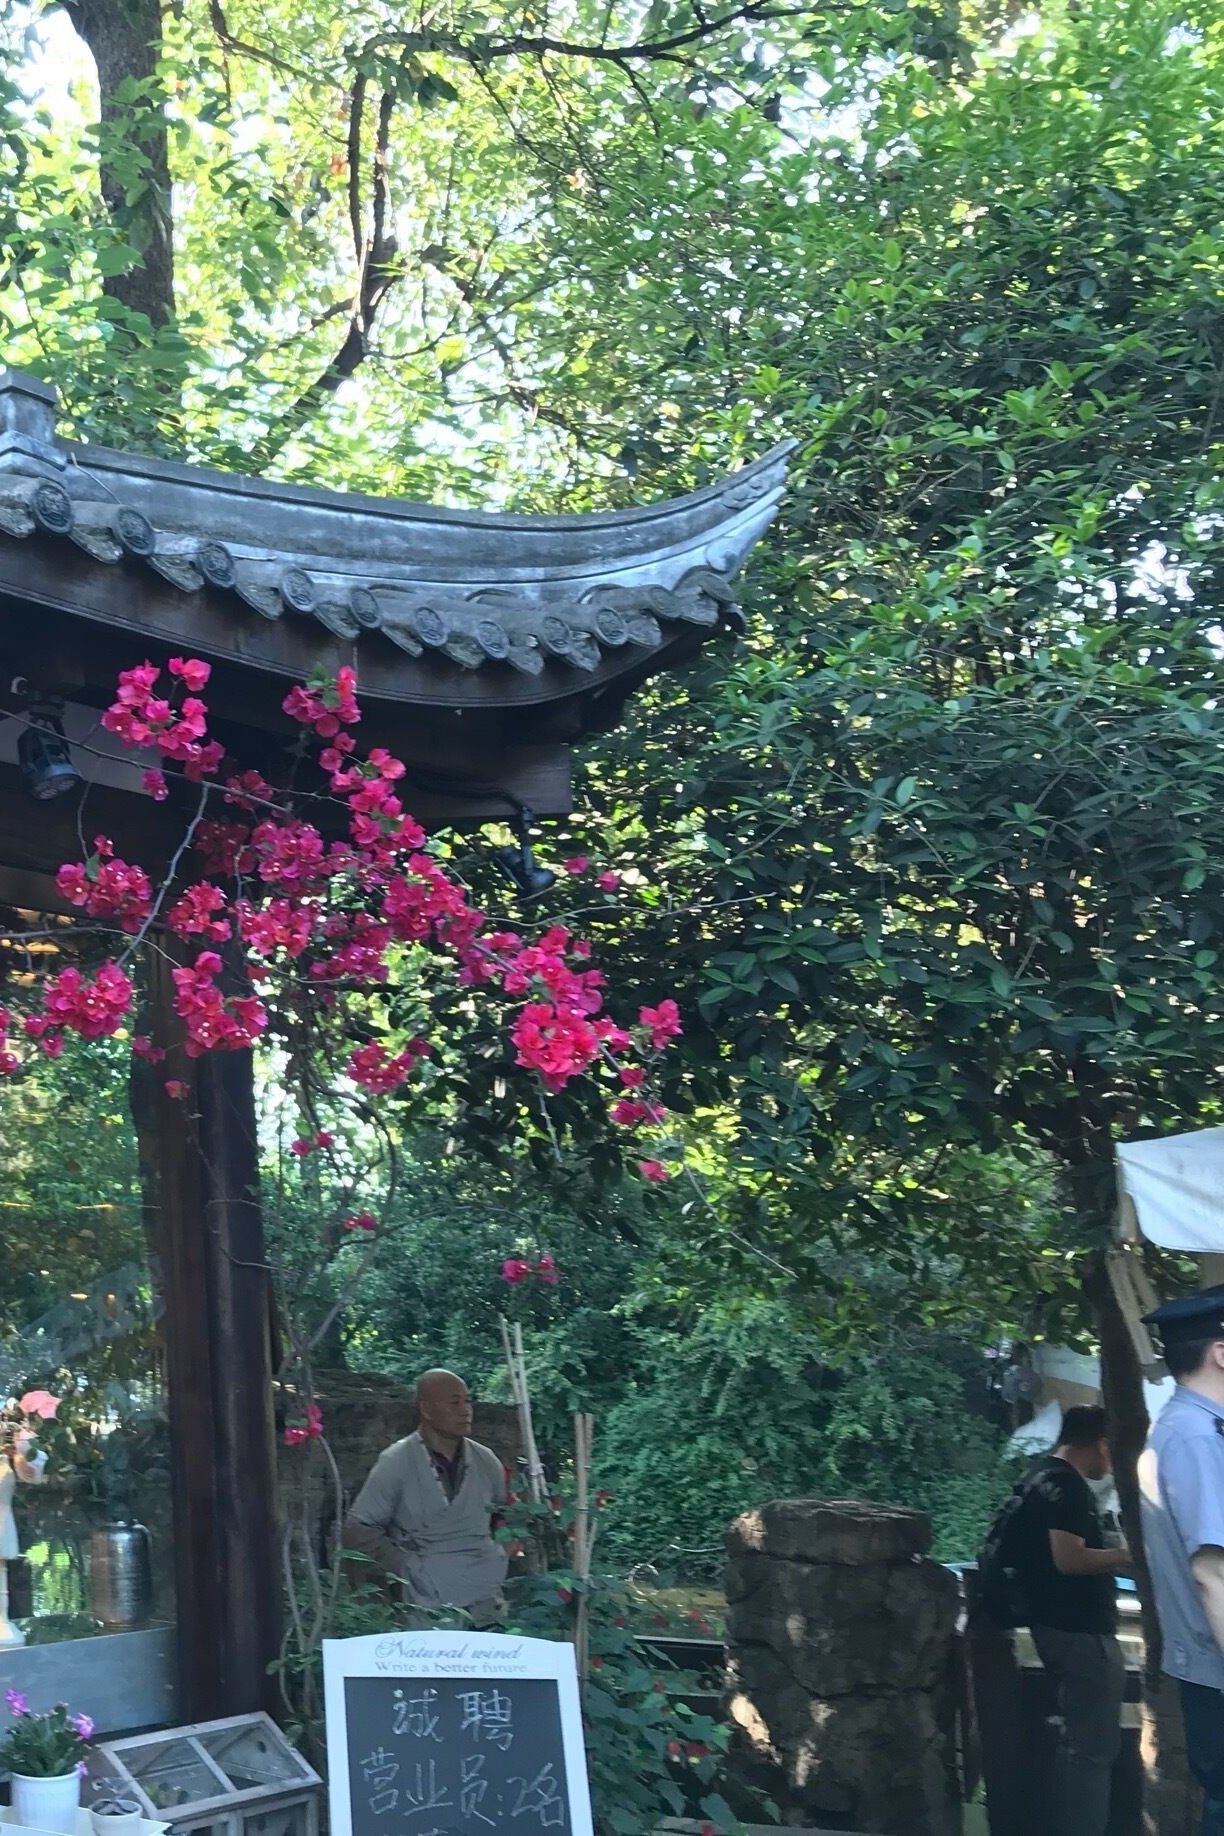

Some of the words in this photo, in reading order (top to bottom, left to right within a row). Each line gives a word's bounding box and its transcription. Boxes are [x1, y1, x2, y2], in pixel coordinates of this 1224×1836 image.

[375, 1636, 469, 1659] Natural
[471, 1643, 524, 1659] wind
[375, 1661, 416, 1673] Write
[422, 1664, 429, 1673] a
[433, 1661, 476, 1673] better
[482, 1662, 527, 1673] future
